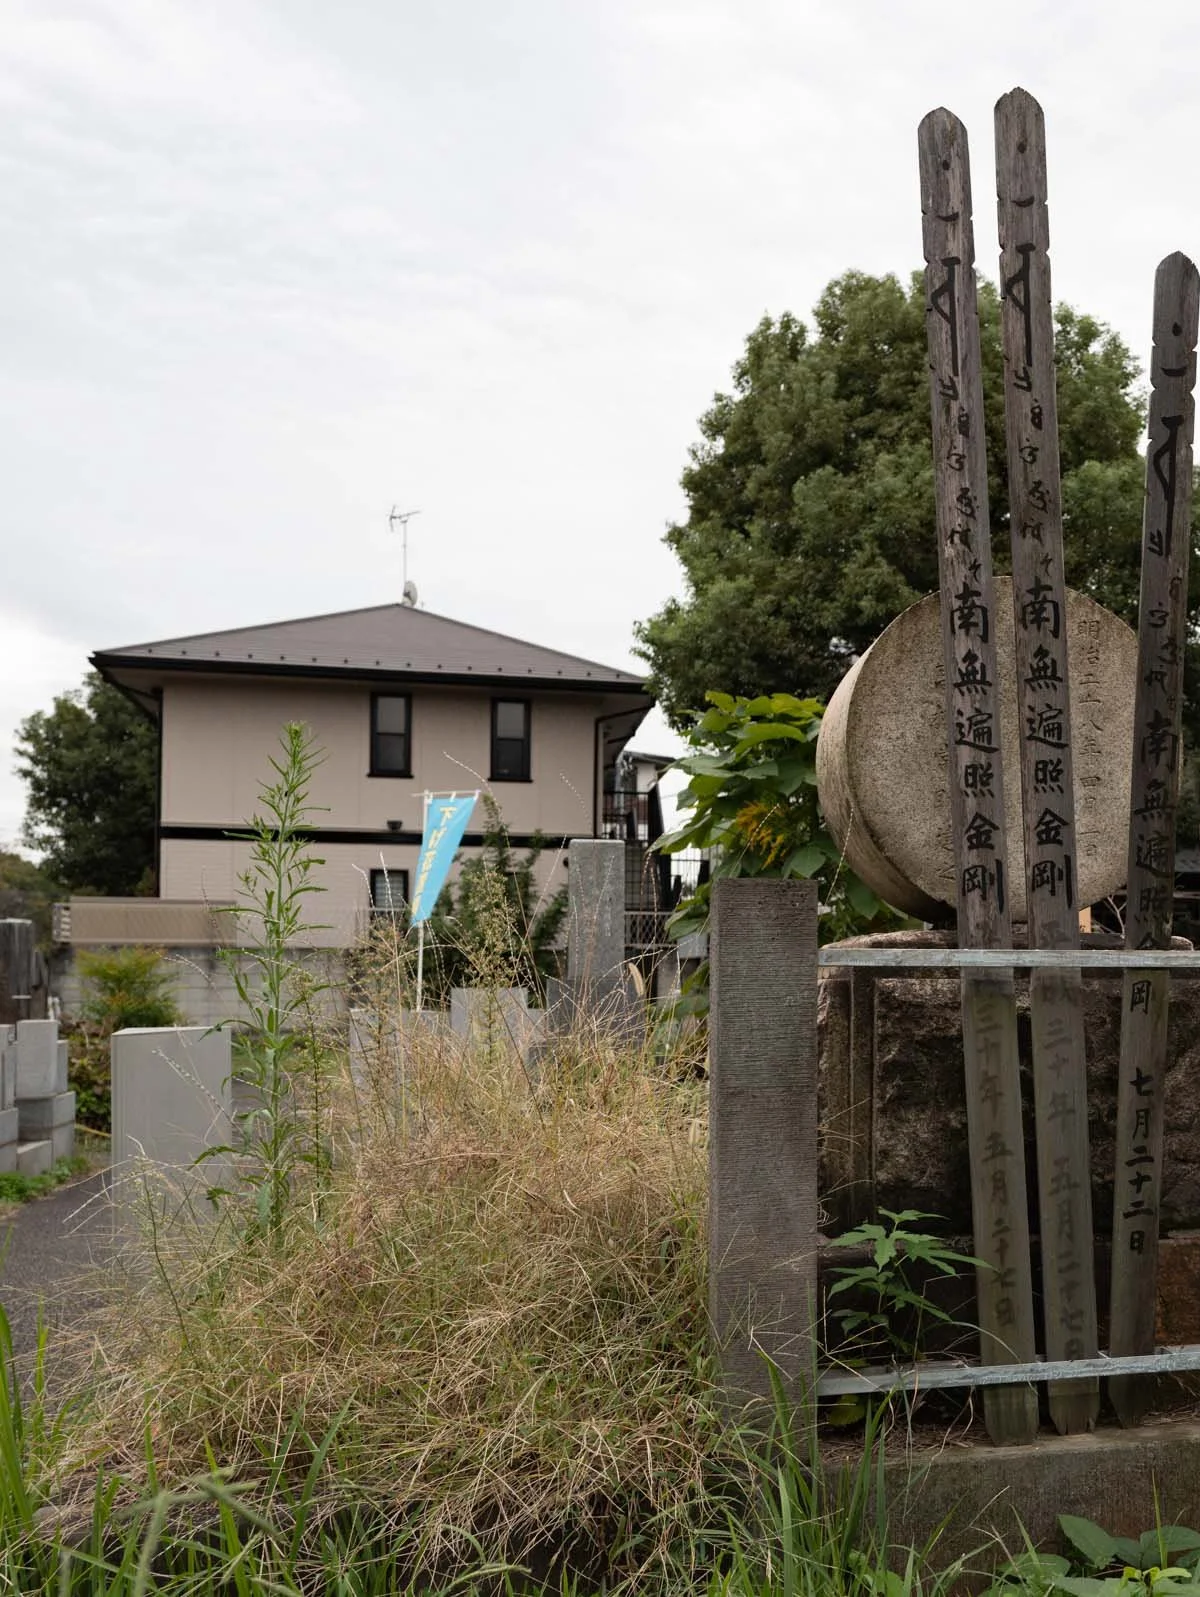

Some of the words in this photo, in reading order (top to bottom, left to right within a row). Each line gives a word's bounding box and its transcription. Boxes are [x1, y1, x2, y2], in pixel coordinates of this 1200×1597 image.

[950, 583, 1005, 913] 南無遍照金剛
[1021, 577, 1073, 909] 南無遍照金剛
[1122, 1068, 1156, 1255] 七月二十二日
